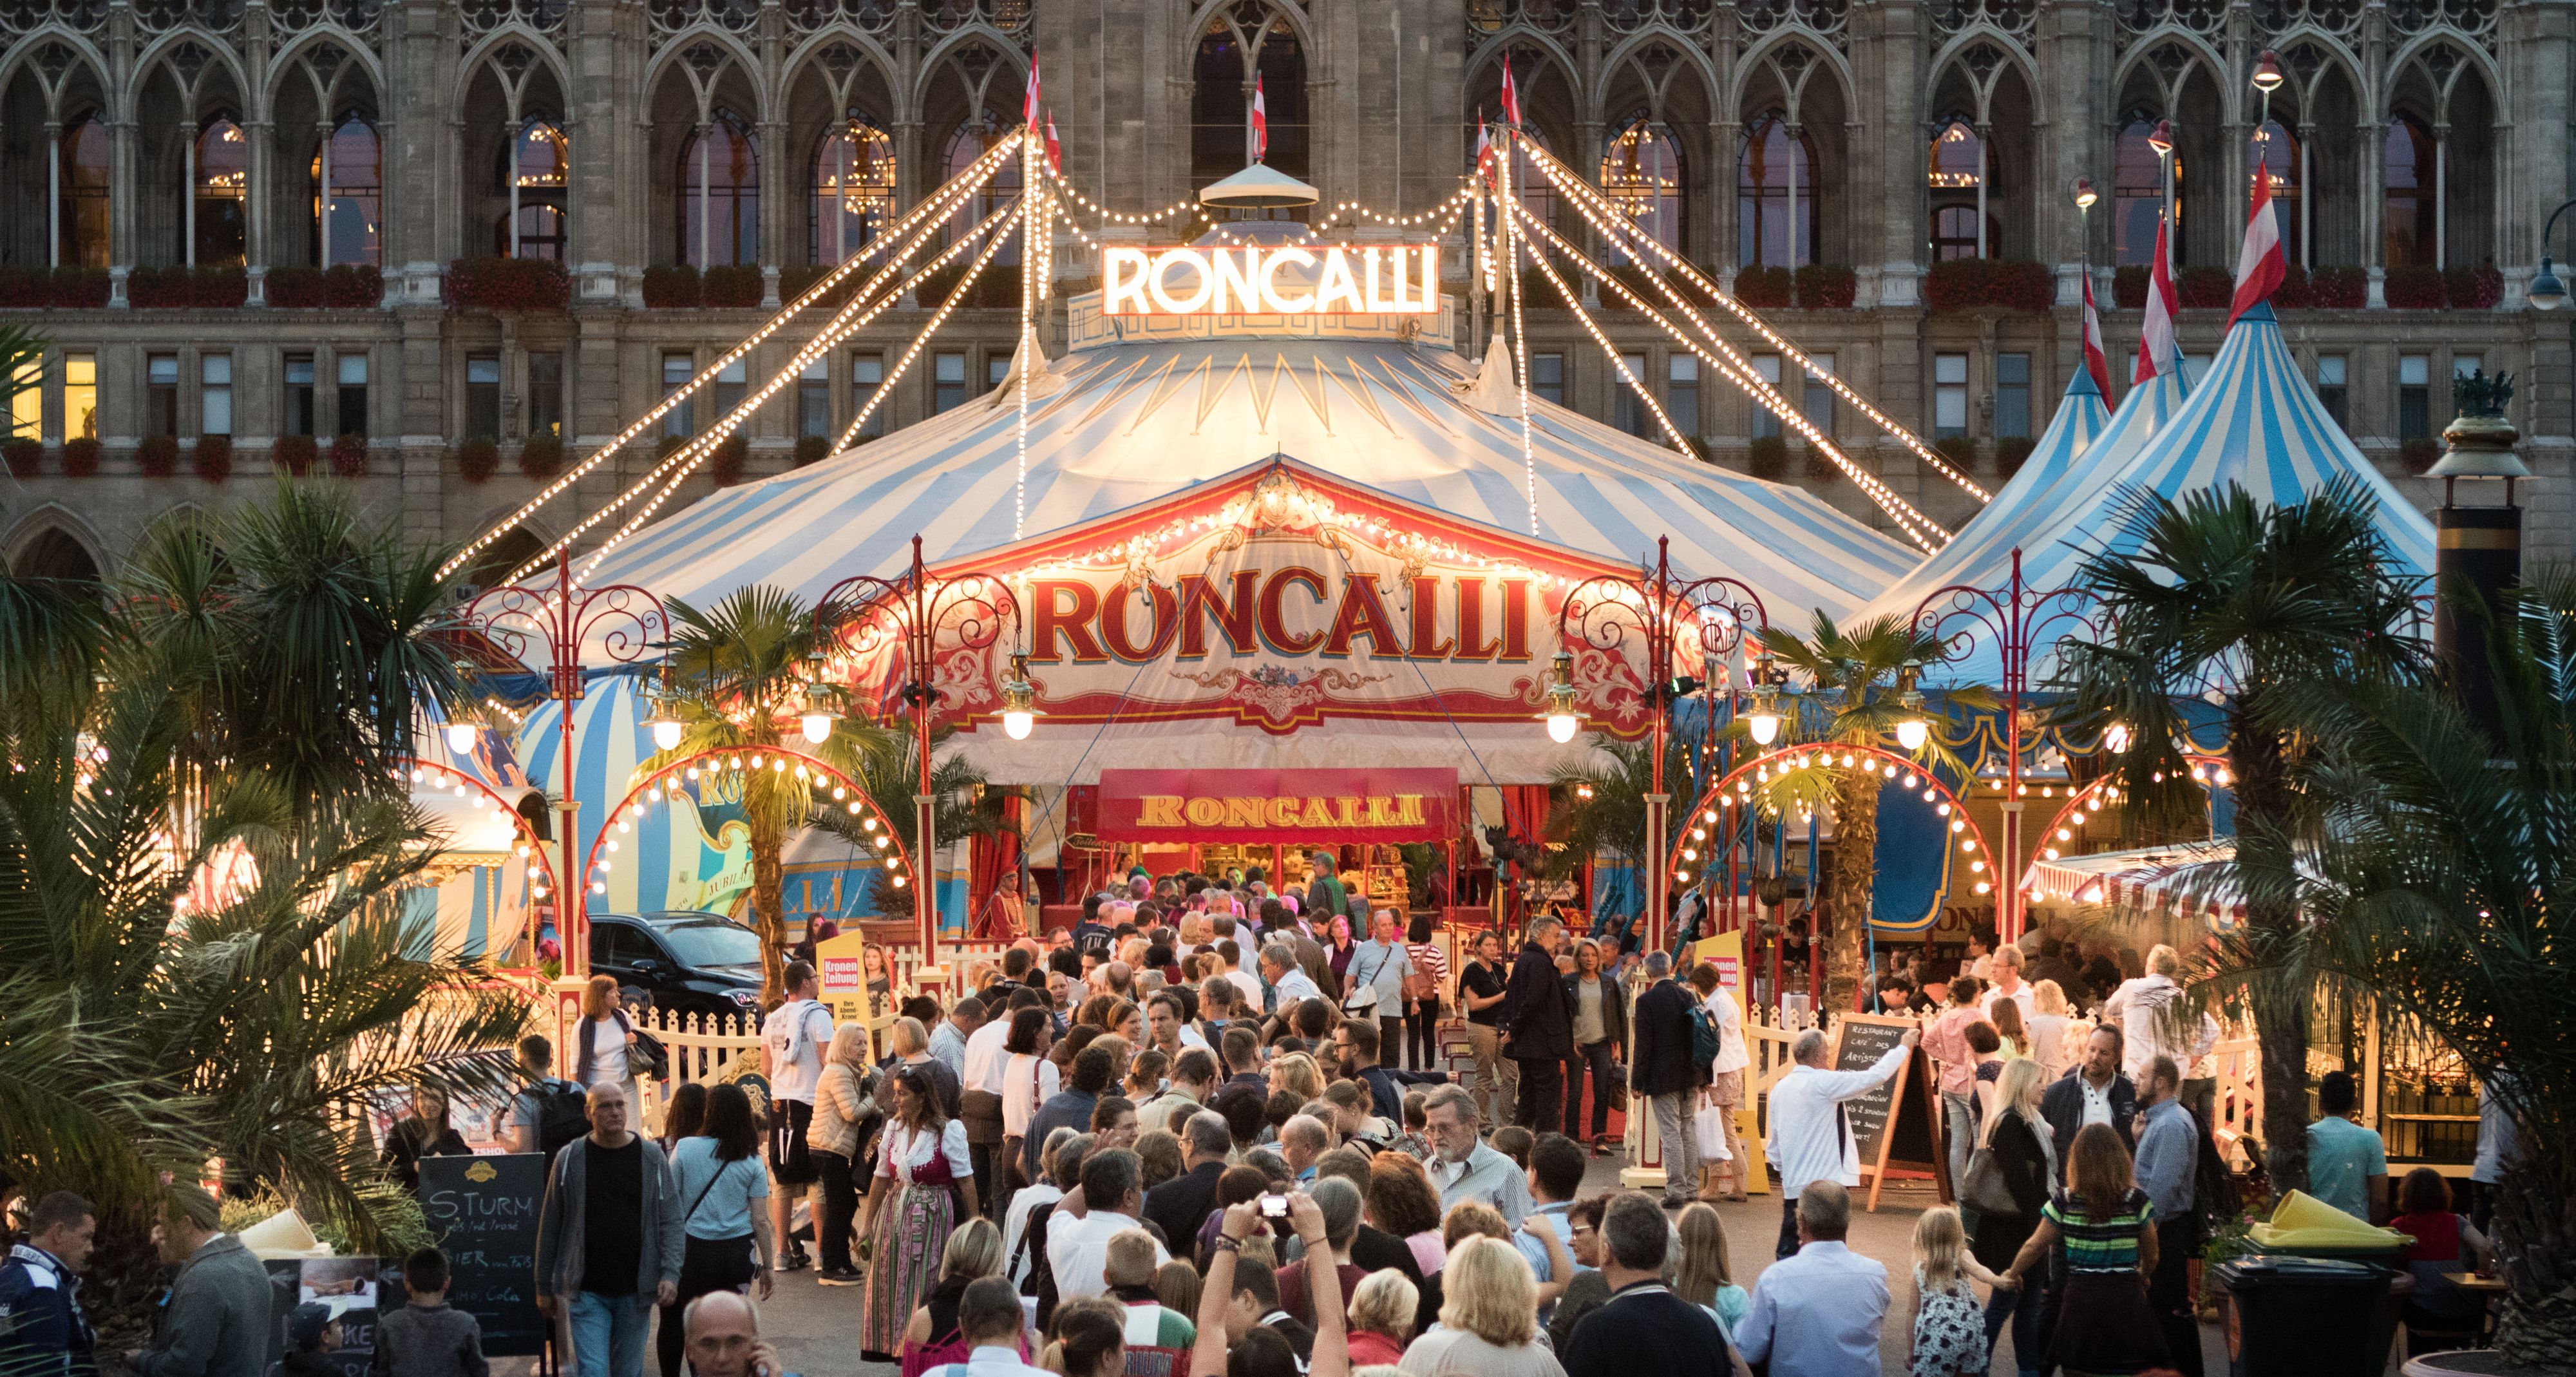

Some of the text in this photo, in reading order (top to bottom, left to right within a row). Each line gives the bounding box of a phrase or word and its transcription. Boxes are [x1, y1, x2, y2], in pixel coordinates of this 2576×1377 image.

[1106, 247, 1438, 314] RONCALLI
[1027, 565, 1534, 665] RONCALLI
[1136, 794, 1426, 828] RONCALLI
[825, 961, 857, 972] Kronen
[825, 973, 857, 984] Zeitung
[429, 1190, 533, 1218] STURM
